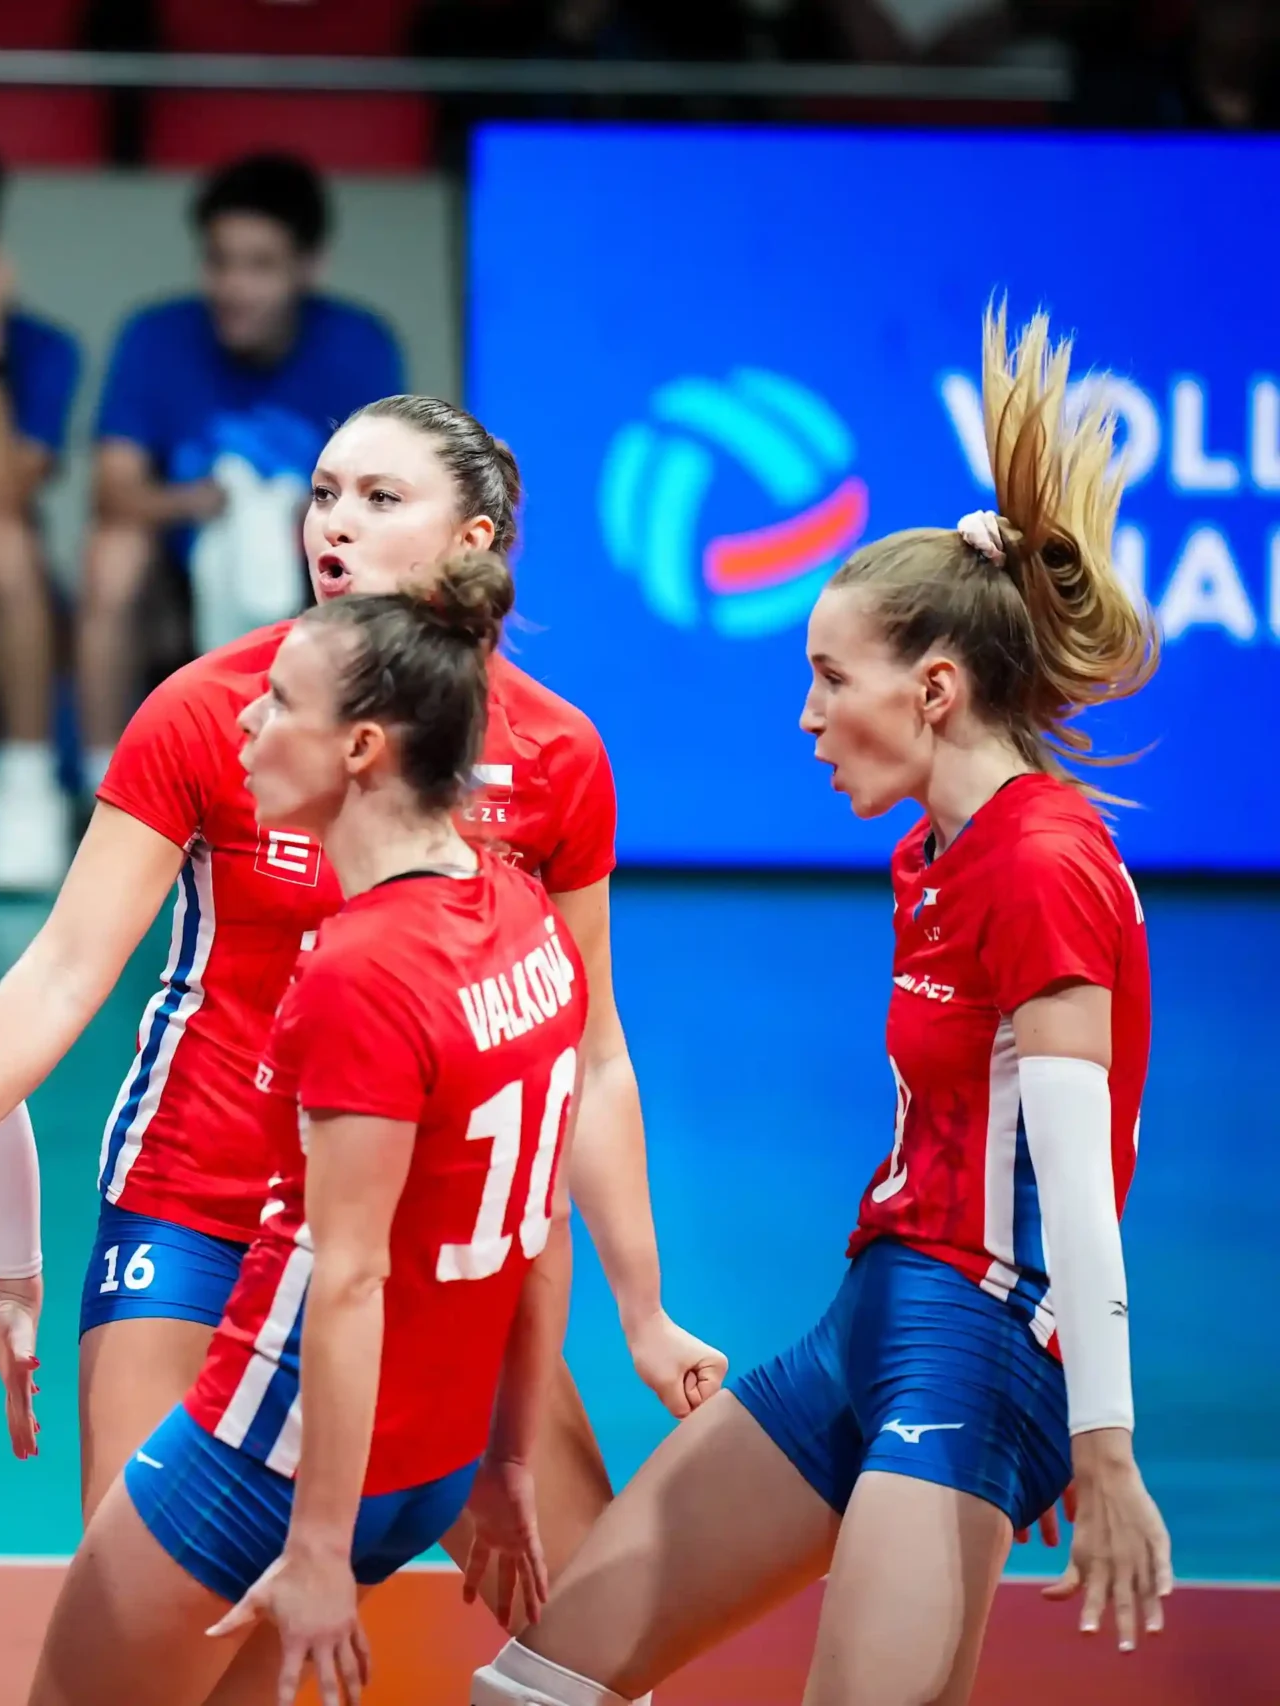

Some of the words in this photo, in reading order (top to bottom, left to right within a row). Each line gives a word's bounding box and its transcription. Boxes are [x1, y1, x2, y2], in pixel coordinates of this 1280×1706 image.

[463, 807, 507, 823] CZE
[436, 1046, 577, 1283] 10
[99, 1243, 156, 1294] 16
